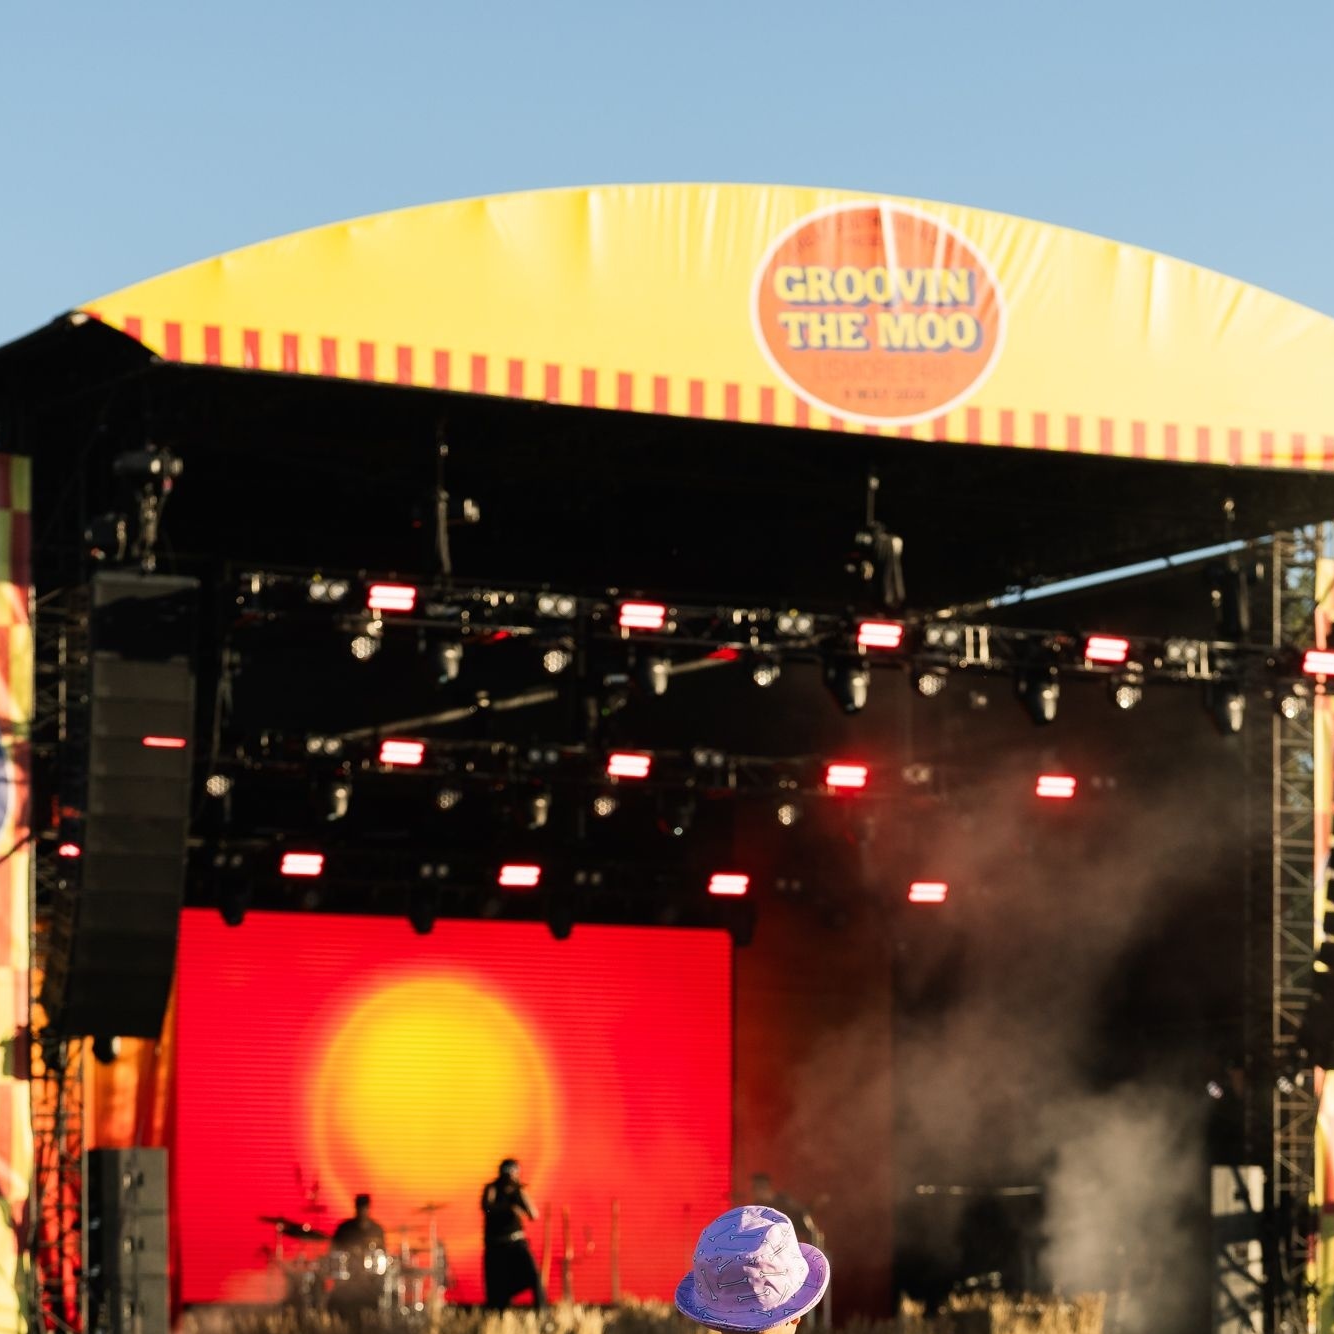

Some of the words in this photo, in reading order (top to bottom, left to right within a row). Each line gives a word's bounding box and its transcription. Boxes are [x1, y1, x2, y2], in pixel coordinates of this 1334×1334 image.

[773, 264, 975, 307] GROOVIN
[777, 311, 869, 351] THE
[877, 313, 983, 353] MOO
